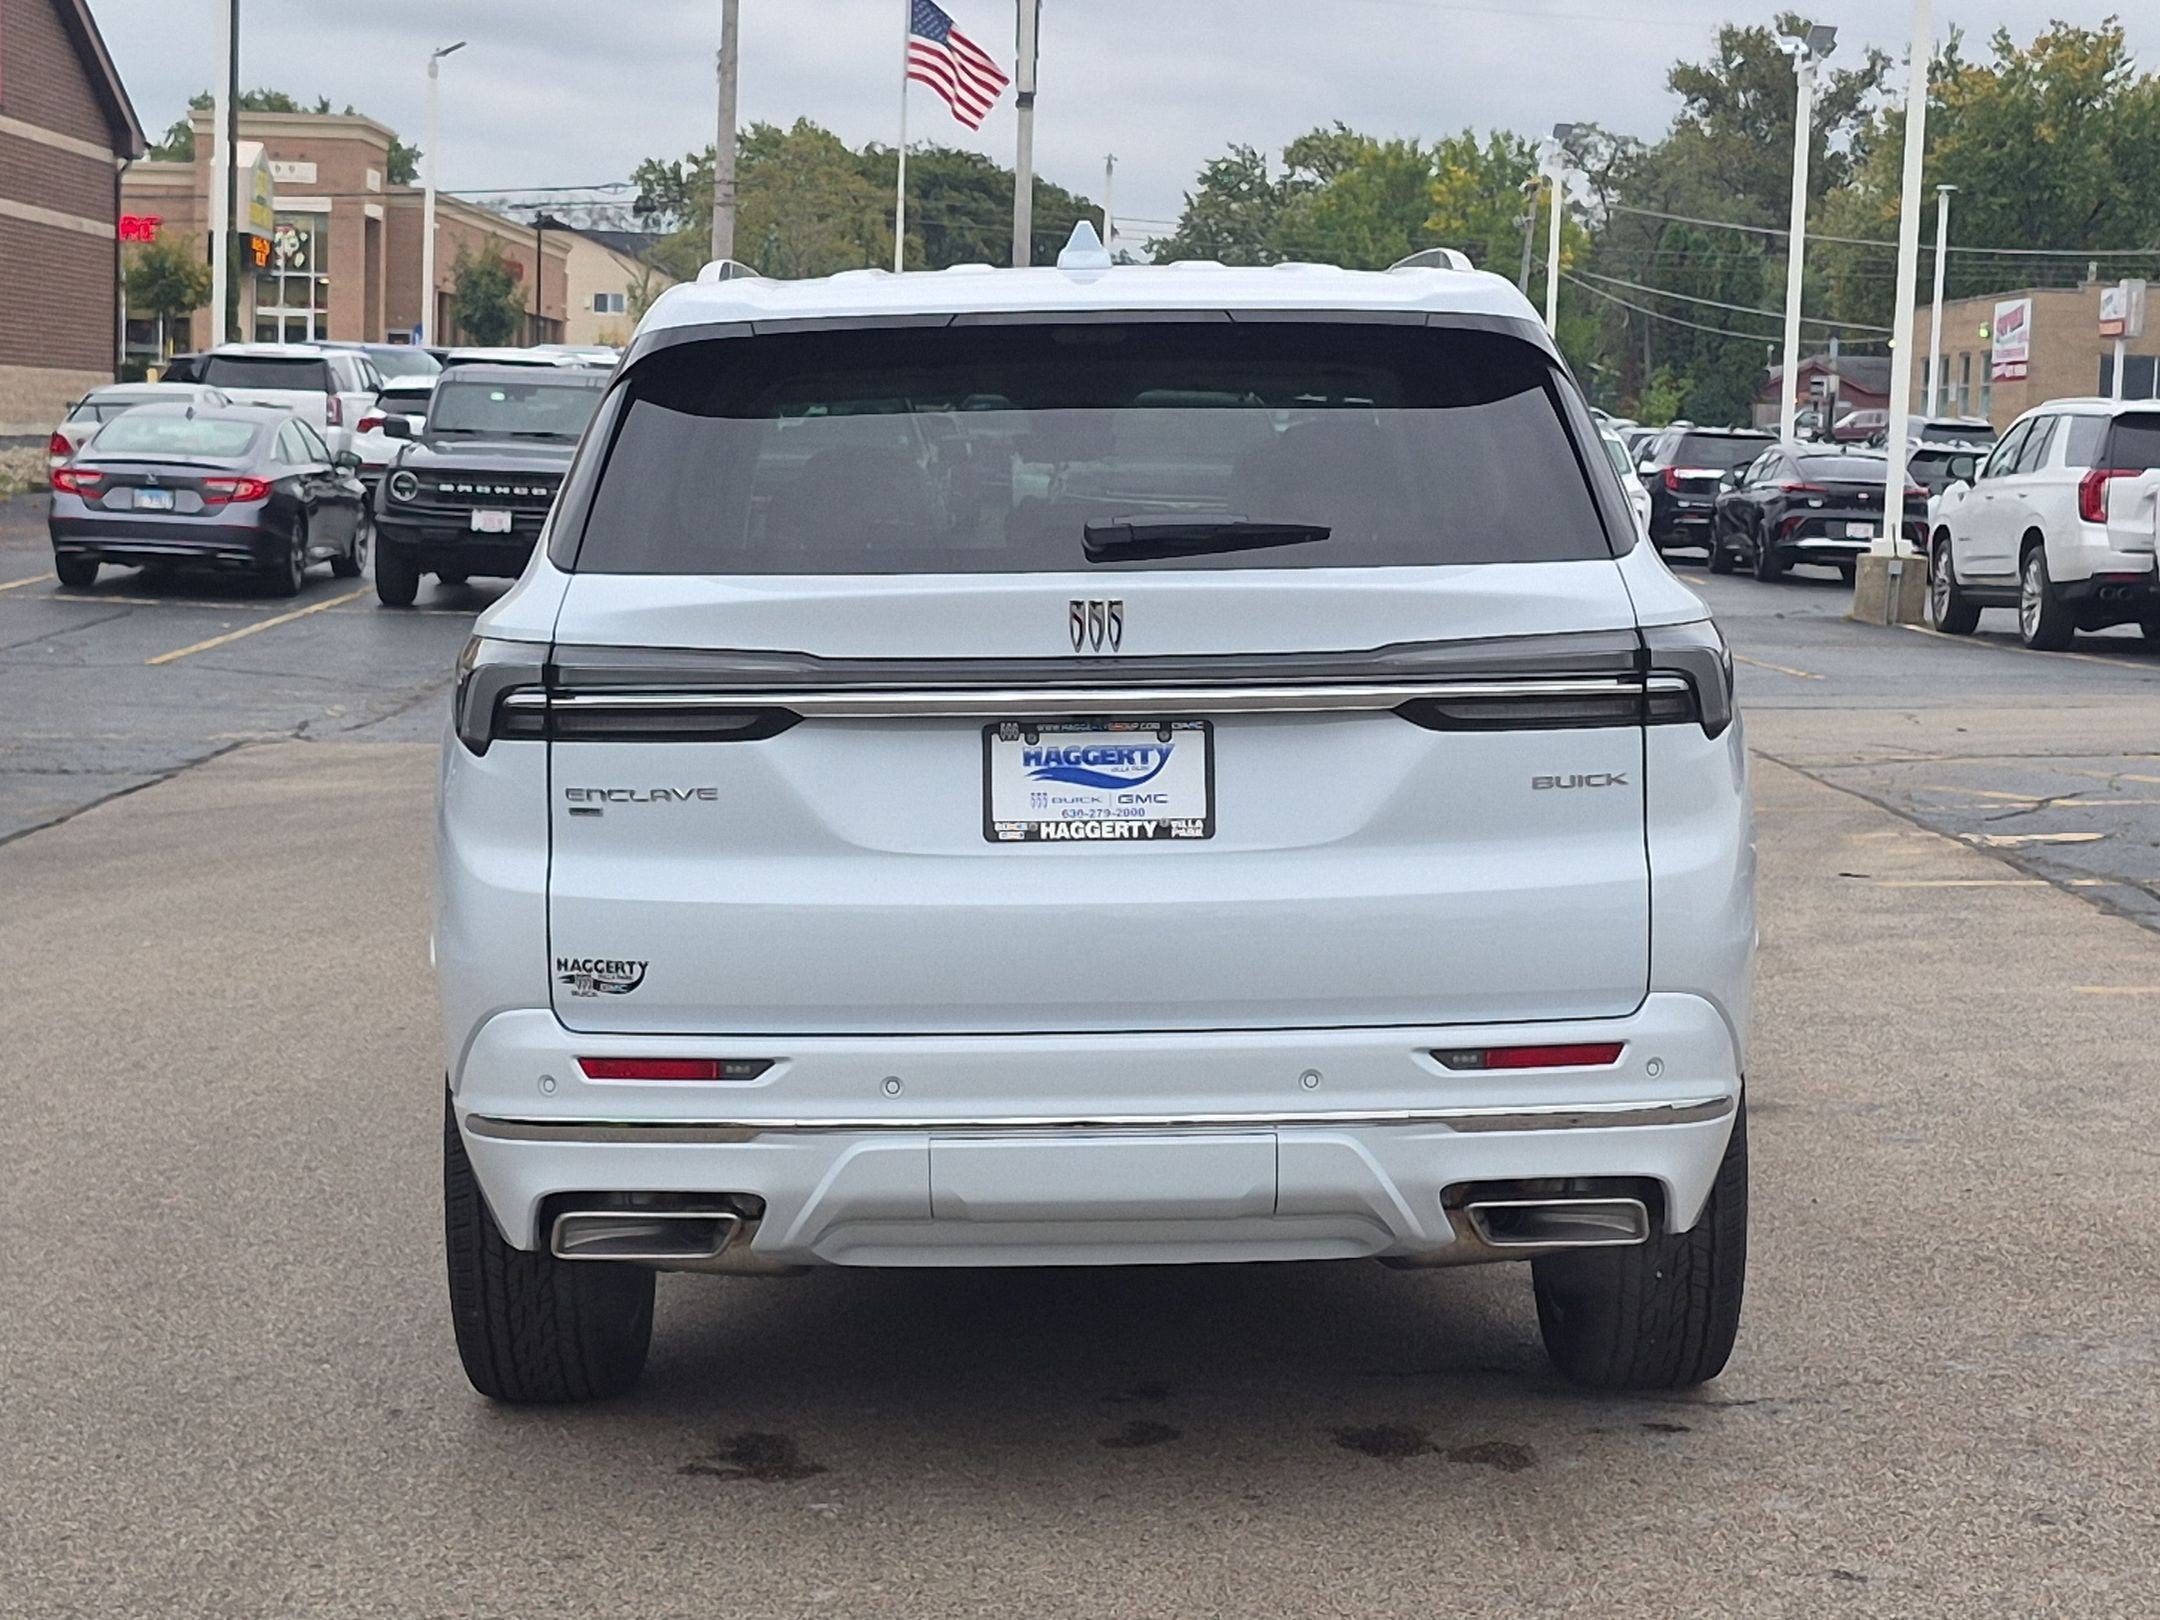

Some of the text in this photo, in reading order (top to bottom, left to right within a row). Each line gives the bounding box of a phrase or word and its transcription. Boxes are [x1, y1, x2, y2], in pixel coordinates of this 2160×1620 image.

[1022, 743, 1176, 767] HAGGERTY
[1531, 772, 1629, 790] BUICK
[565, 787, 719, 803] ENCLAVE
[1051, 794, 1168, 804] BUICK GMC
[1061, 807, 1146, 819] 630-279-2000
[1040, 820, 1157, 839] HAGGERTY
[556, 957, 650, 975] HAGGERTY
